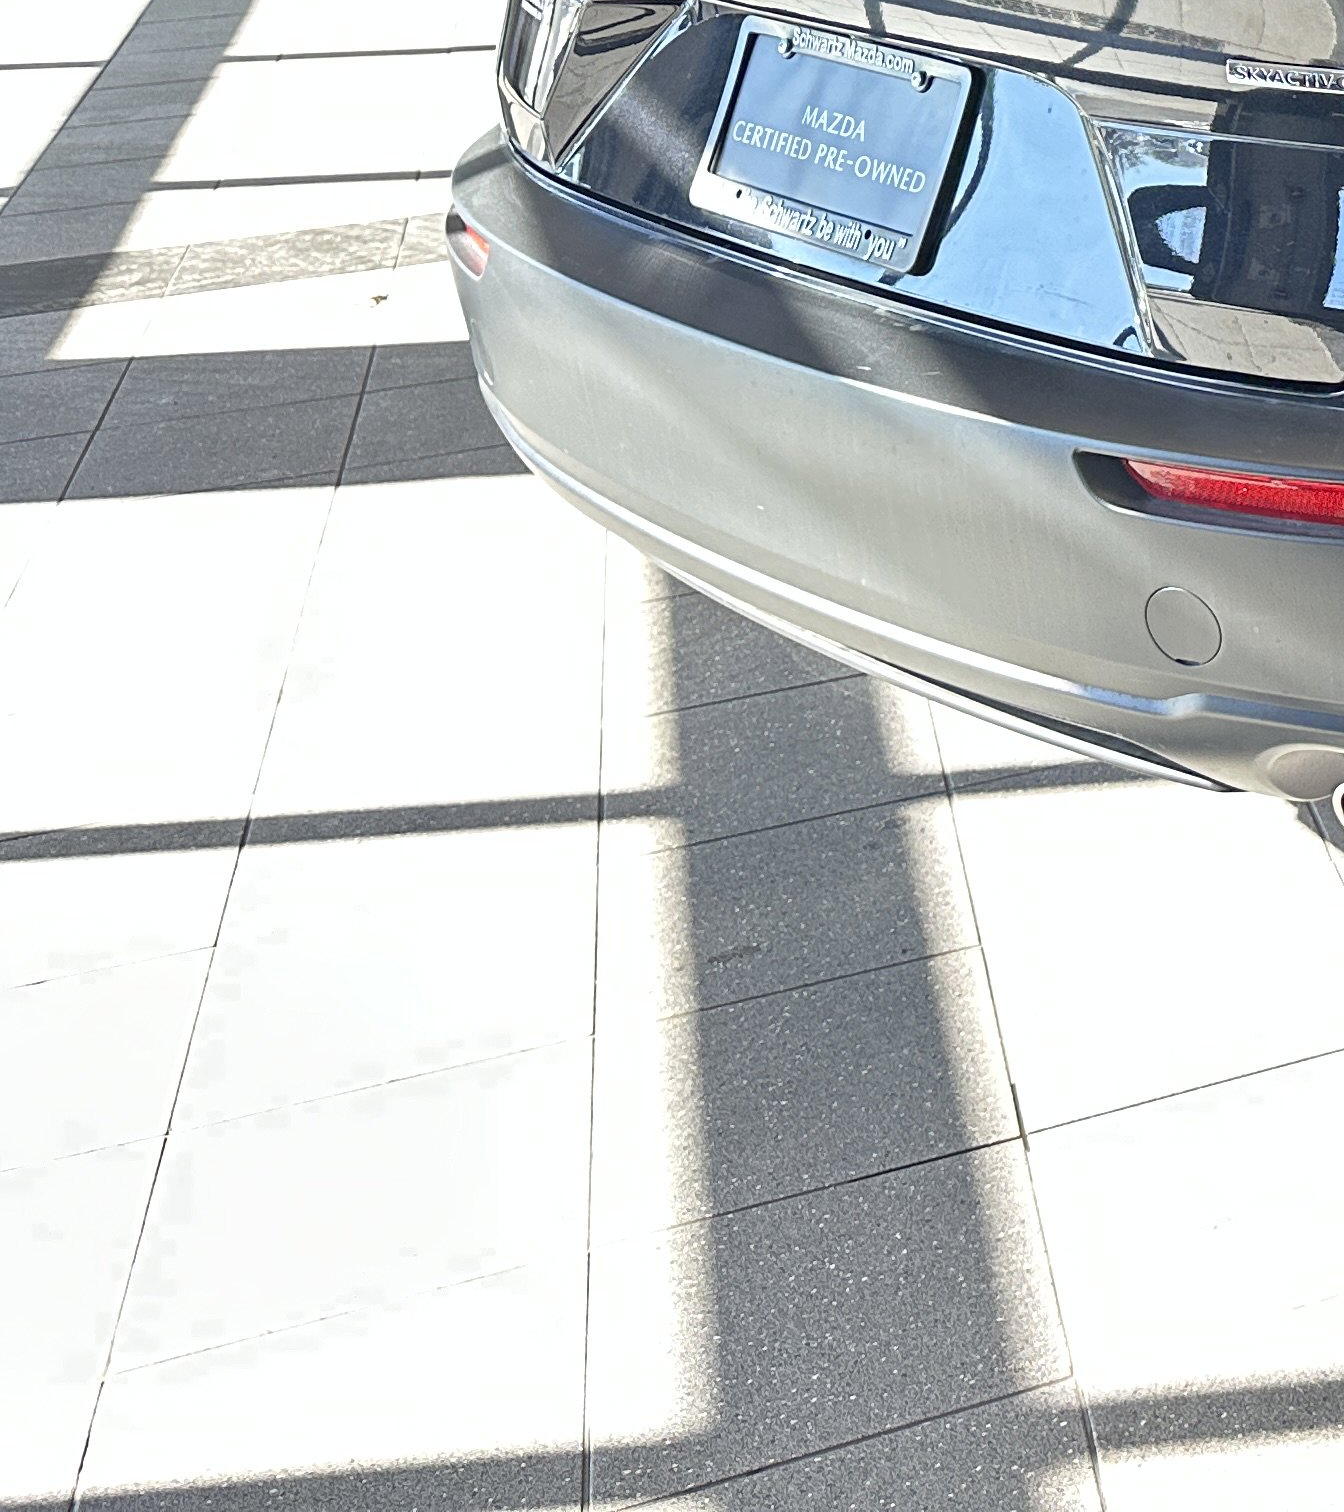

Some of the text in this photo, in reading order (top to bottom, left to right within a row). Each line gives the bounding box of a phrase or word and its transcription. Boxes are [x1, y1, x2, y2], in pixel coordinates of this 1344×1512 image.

[801, 105, 866, 143] MAZDA
[732, 120, 927, 194] CERTIFIED PRE-OWNED
[762, 194, 818, 237] Schwartz
[815, 213, 835, 242] be
[833, 221, 863, 250] with
